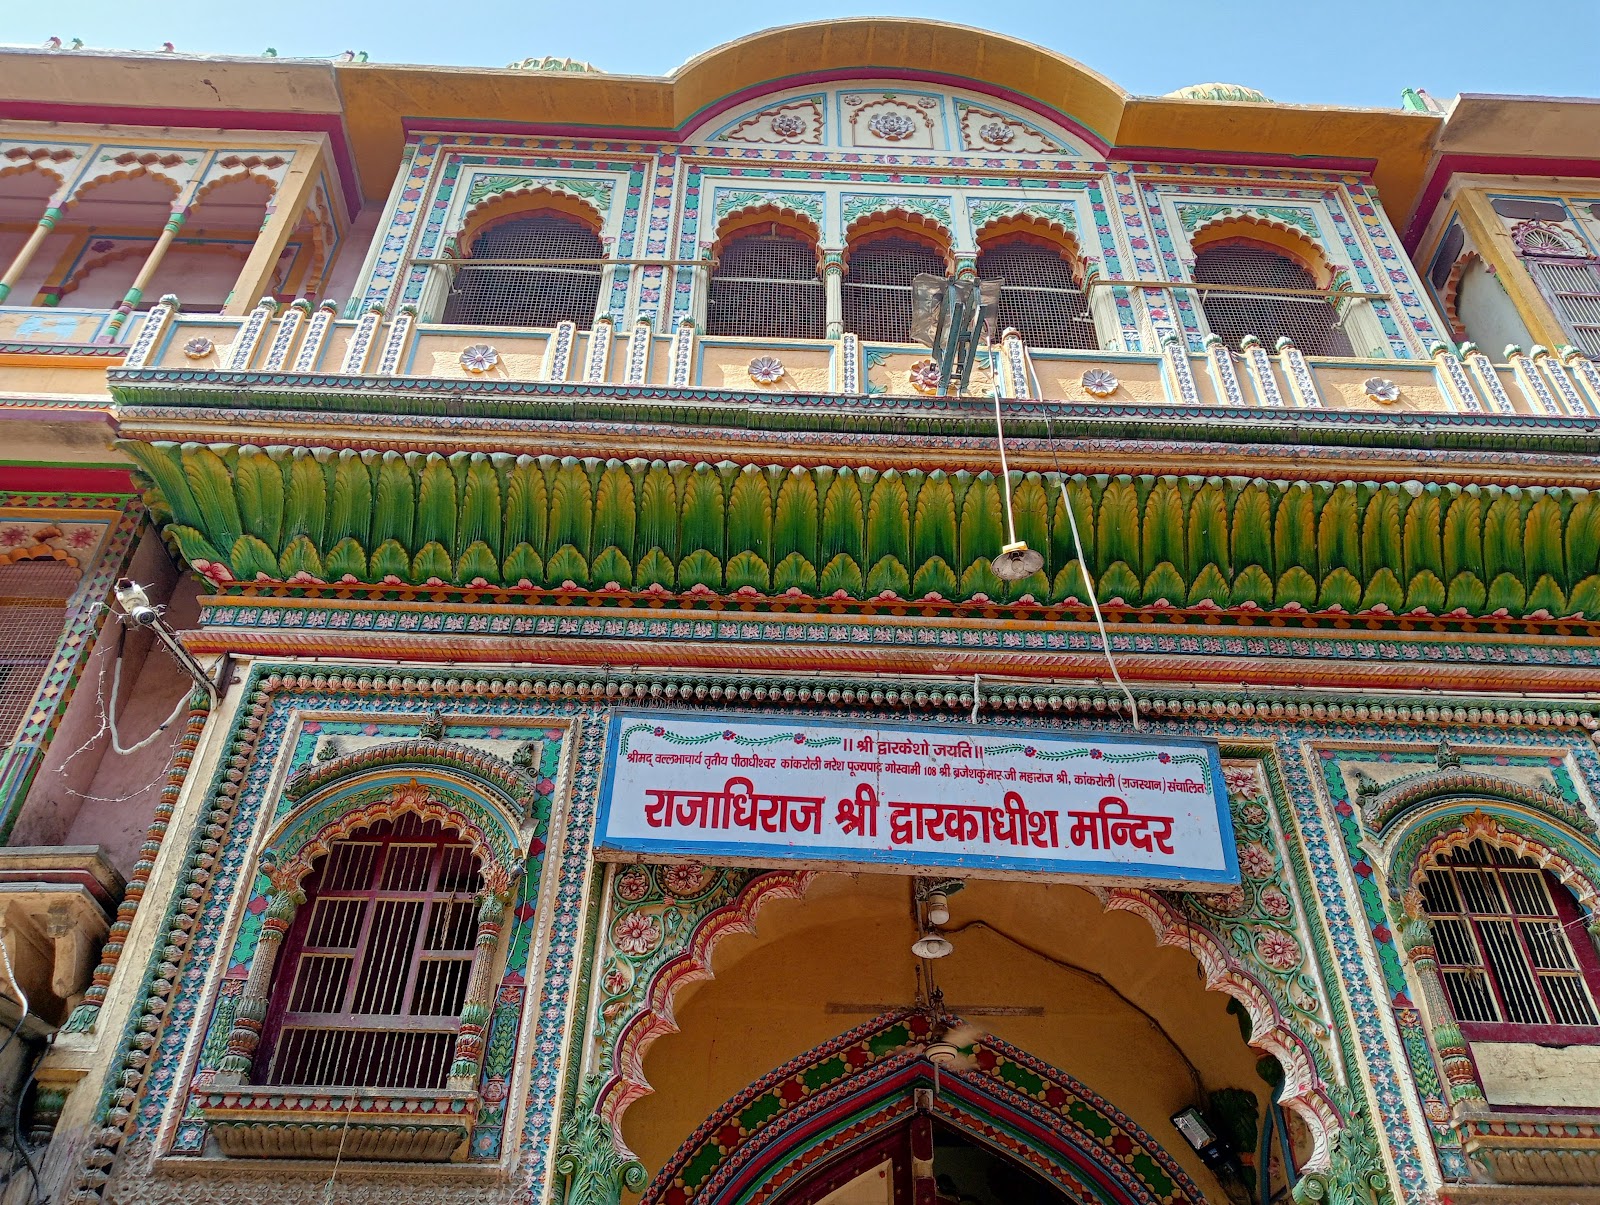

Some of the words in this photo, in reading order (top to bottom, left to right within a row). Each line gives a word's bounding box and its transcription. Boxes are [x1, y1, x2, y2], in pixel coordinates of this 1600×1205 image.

[857, 735, 873, 753] श्री
[877, 738, 929, 756] द्वारकेशो
[627, 749, 654, 768] श्रीमद्
[655, 751, 702, 765] वल्लभाचार्य
[704, 752, 728, 769] तृतीय
[731, 753, 776, 769] पीठाधीश्वर
[781, 756, 822, 770] कांकरोली
[824, 757, 845, 771] नरेश
[847, 761, 883, 777] पूज्यपाद
[885, 760, 921, 776] गोस्वामी
[924, 767, 937, 776] 108
[939, 763, 951, 777] श्री
[953, 765, 1002, 785] ब्रजेशकुमार
[1004, 767, 1017, 781] जी
[1019, 771, 1054, 783] महाराज
[1074, 772, 1116, 788] कांकरोली
[1167, 778, 1206, 794] संचालित
[644, 776, 826, 835] राजाधिराज
[835, 783, 881, 837] श्री
[888, 791, 1060, 848] द्वारकाधीश
[1067, 796, 1175, 855] मन्दिर
